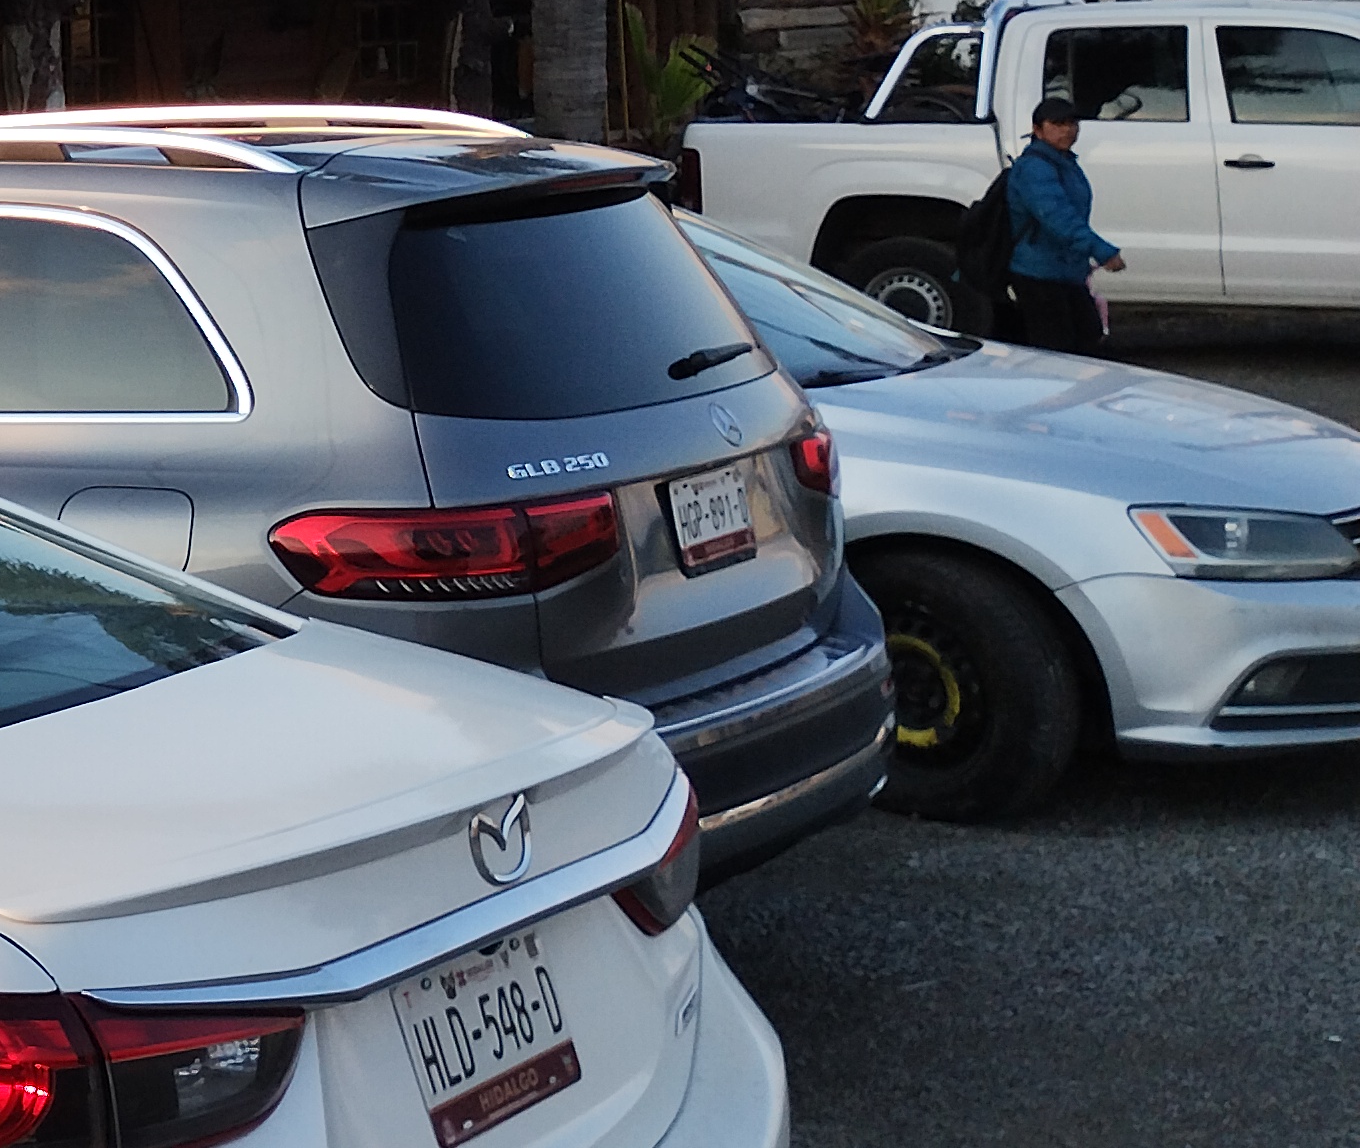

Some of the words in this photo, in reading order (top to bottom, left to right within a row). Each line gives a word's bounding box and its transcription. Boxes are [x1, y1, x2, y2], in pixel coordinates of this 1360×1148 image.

[507, 459, 561, 479] GLB
[563, 452, 610, 473] 250
[413, 965, 563, 1095] HLD-548-D
[478, 1067, 540, 1113] HIDALGO
